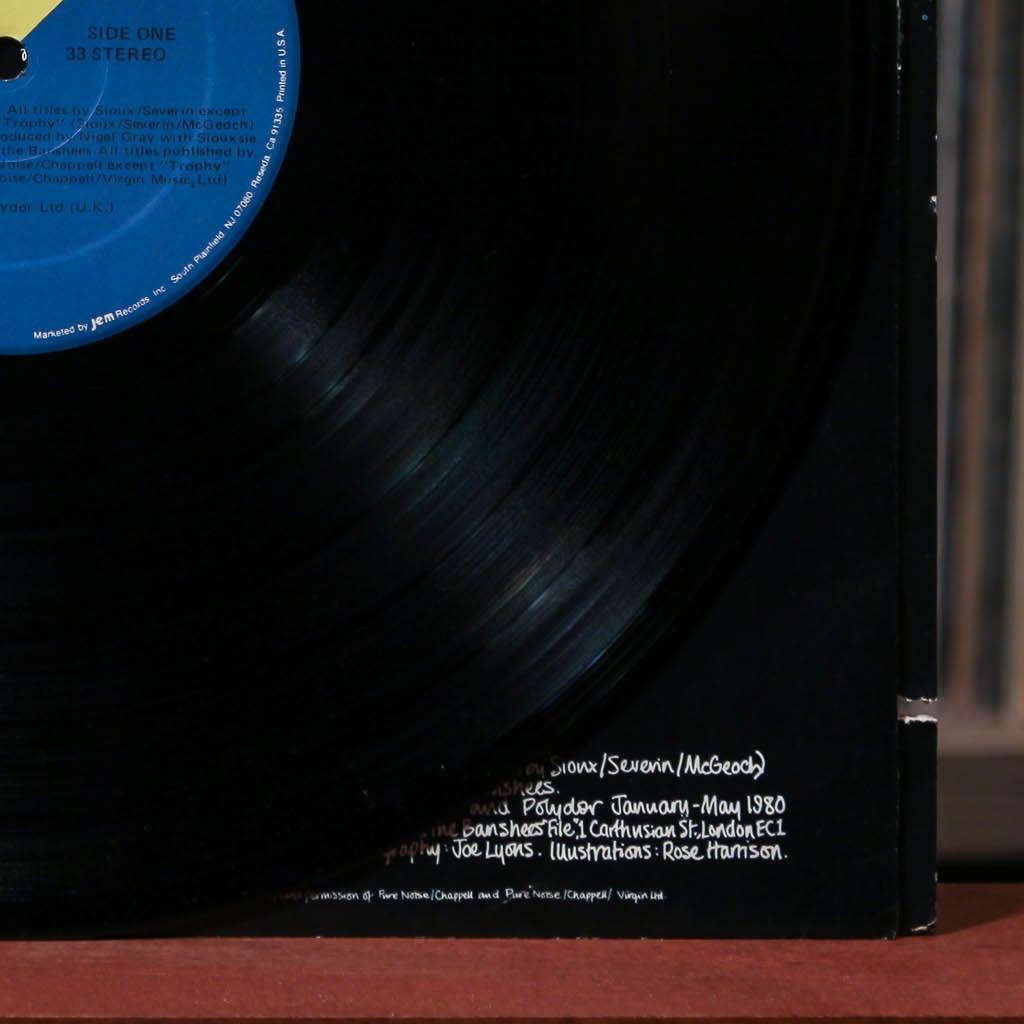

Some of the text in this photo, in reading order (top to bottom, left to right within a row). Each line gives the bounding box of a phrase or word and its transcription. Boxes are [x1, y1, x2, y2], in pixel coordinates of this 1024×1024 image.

[87, 25, 176, 41] SIDE ONE
[64, 46, 167, 62] 33 STEREO
[279, 59, 287, 68] in
[276, 70, 287, 103] Printed
[7, 104, 28, 115] All
[33, 104, 68, 115] titles
[270, 107, 284, 136] 91335
[79, 132, 116, 144] Nigel
[122, 132, 154, 144] Gray
[160, 132, 191, 143] with
[198, 133, 256, 144] Siouxsie
[265, 137, 277, 150] Ca
[2, 145, 24, 156] the
[124, 145, 159, 156] titles
[163, 146, 232, 158] published
[237, 147, 255, 159] by
[108, 160, 155, 171] except
[39, 200, 64, 214] Ltd
[233, 191, 253, 217] 07080
[193, 230, 225, 264] Plainfield
[170, 263, 194, 284] South
[115, 296, 150, 319] Records
[33, 325, 76, 340] Marketed
[77, 323, 88, 333] by
[522, 797, 604, 821] Polydor
[746, 794, 786, 815] 1980
[589, 819, 676, 838] Carthusian
[757, 818, 786, 837] EC1
[452, 838, 482, 859] Joe
[485, 840, 543, 865] Lyons.
[662, 840, 705, 861] Rose
[362, 888, 372, 903] of
[378, 888, 398, 900] Pure
[477, 888, 500, 899] and
[505, 887, 530, 899] Pure
[616, 888, 648, 904] Virgin
